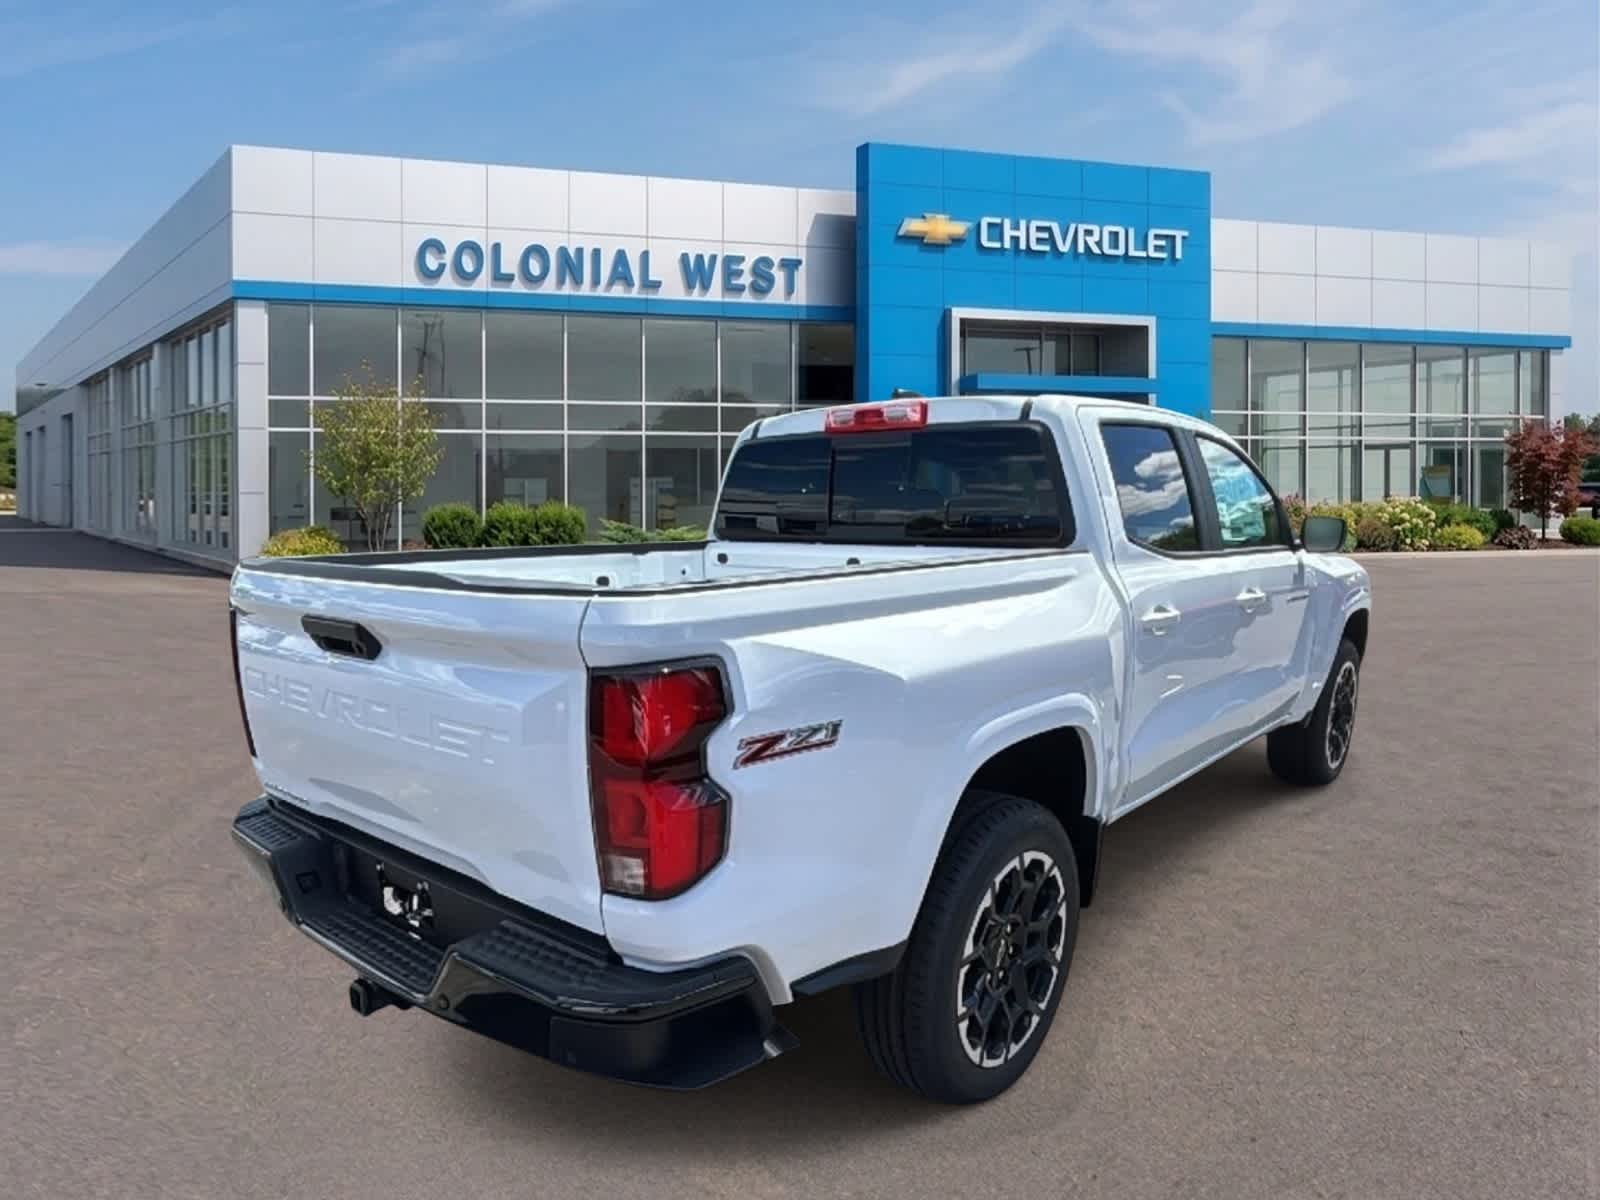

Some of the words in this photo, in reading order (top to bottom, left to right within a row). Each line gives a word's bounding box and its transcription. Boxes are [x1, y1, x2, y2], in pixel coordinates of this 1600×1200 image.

[980, 216, 1189, 259] CHEVROLET
[417, 238, 662, 289] COLONIAL
[680, 252, 803, 296] WEST
[245, 666, 511, 765] CHEVROLET
[732, 719, 844, 770] Z71
